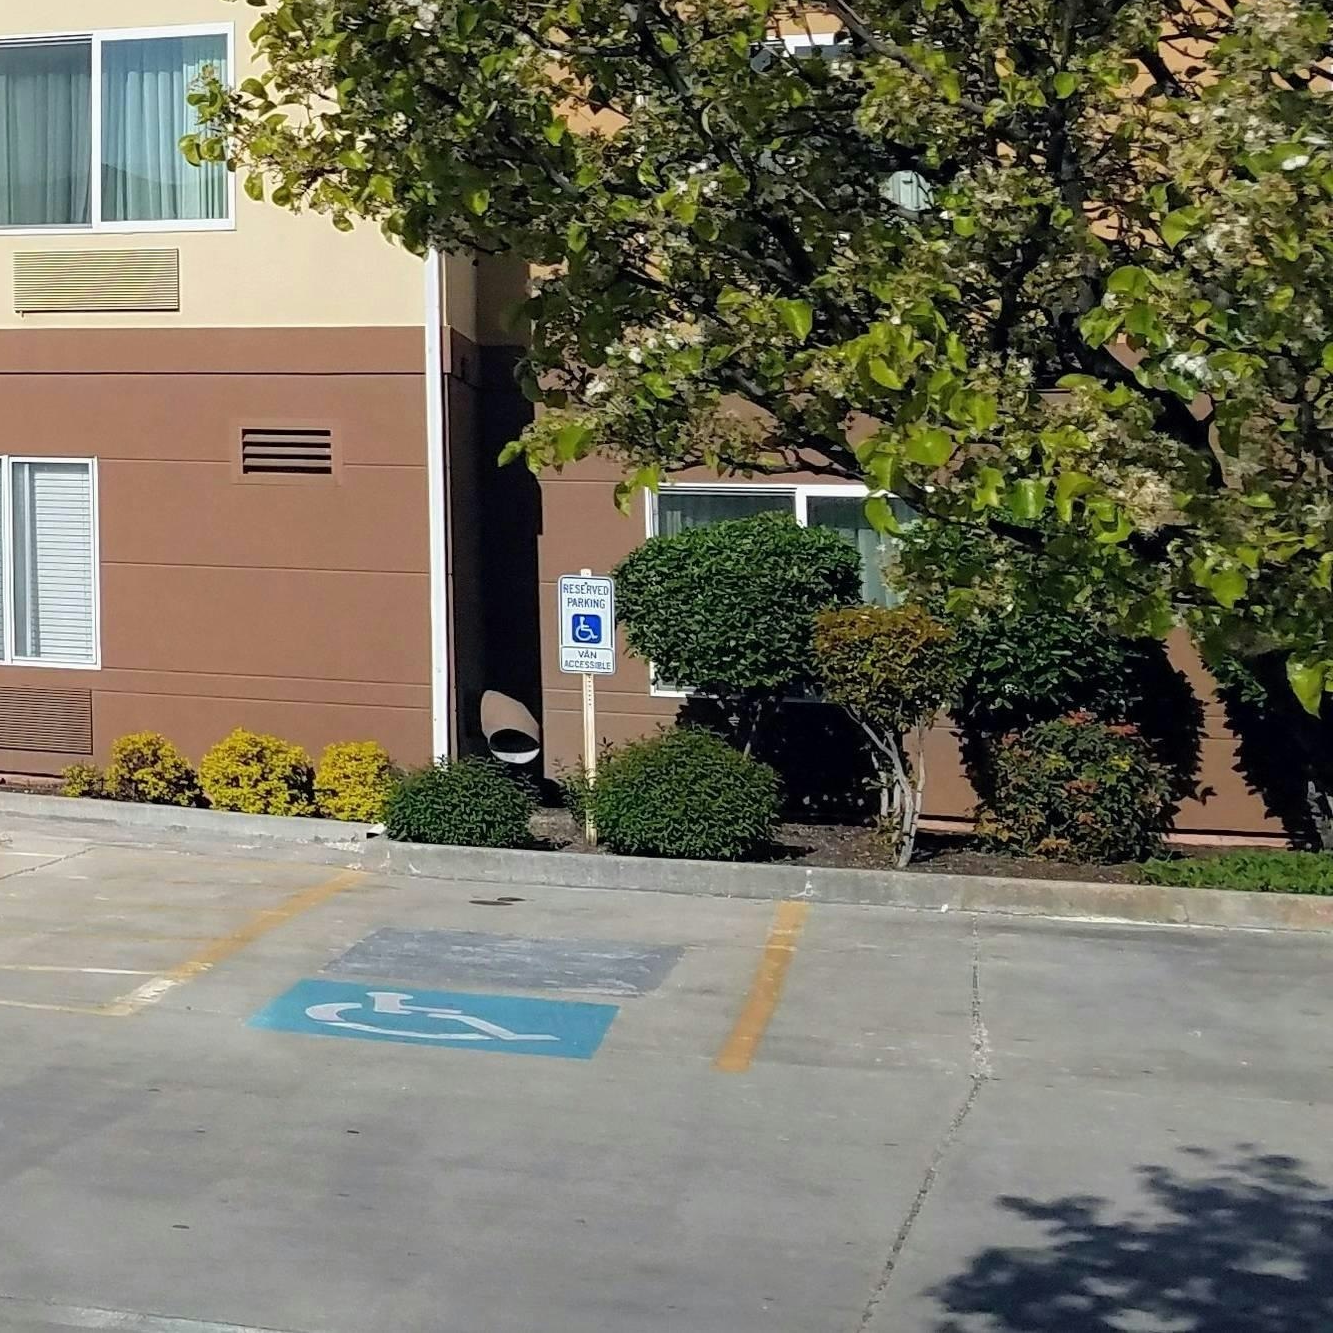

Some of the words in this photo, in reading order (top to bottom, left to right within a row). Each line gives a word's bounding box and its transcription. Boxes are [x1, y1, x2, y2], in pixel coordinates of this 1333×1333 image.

[563, 583, 609, 596] RESERVED
[567, 597, 606, 609] PARKING
[577, 650, 597, 659] VAN
[564, 660, 612, 670] ACCESSIBLE
